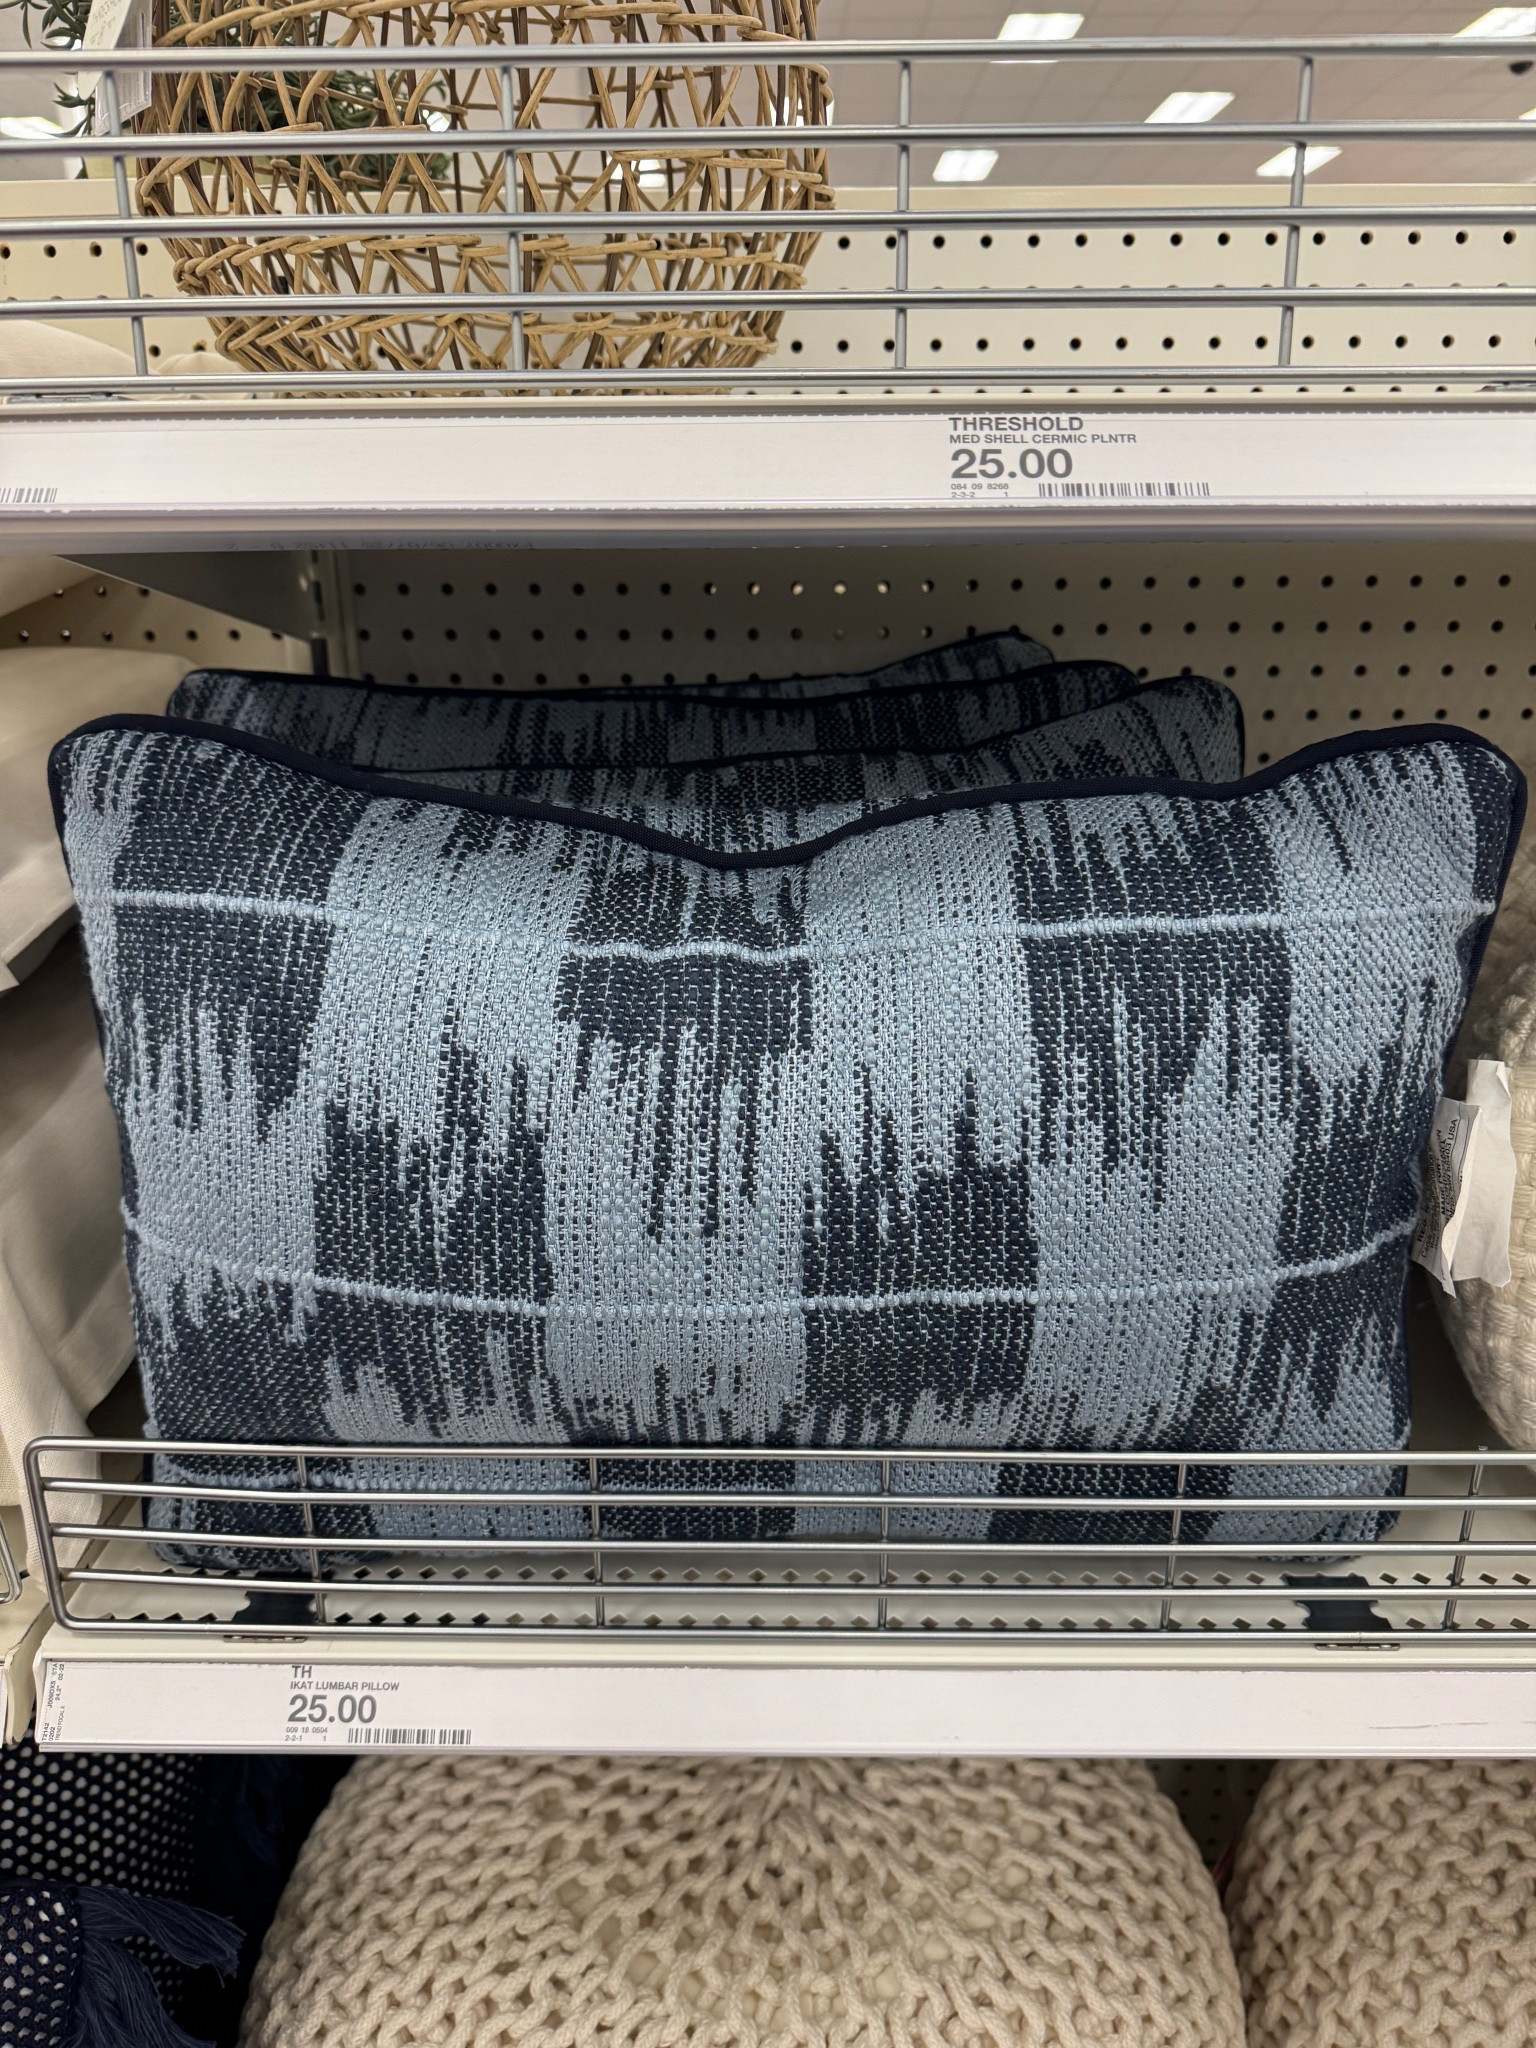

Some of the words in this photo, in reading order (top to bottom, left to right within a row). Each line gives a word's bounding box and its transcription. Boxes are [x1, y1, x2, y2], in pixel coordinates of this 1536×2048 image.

[949, 416, 1084, 432] THRESHOLD
[949, 434, 981, 444] MED
[984, 434, 1029, 444] SHELL
[1031, 434, 1087, 444] CERMIC
[1091, 434, 1137, 444] PLNTR
[951, 448, 1073, 479] 25.00
[950, 483, 968, 491] 084
[971, 483, 983, 491] 09
[1447, 1118, 1458, 1142] USA
[291, 1665, 312, 1678] TH
[290, 1681, 313, 1690] IKAT
[315, 1681, 359, 1691] LUMBAR
[361, 1682, 400, 1691] PILLOW
[288, 1694, 377, 1723] 25.00
